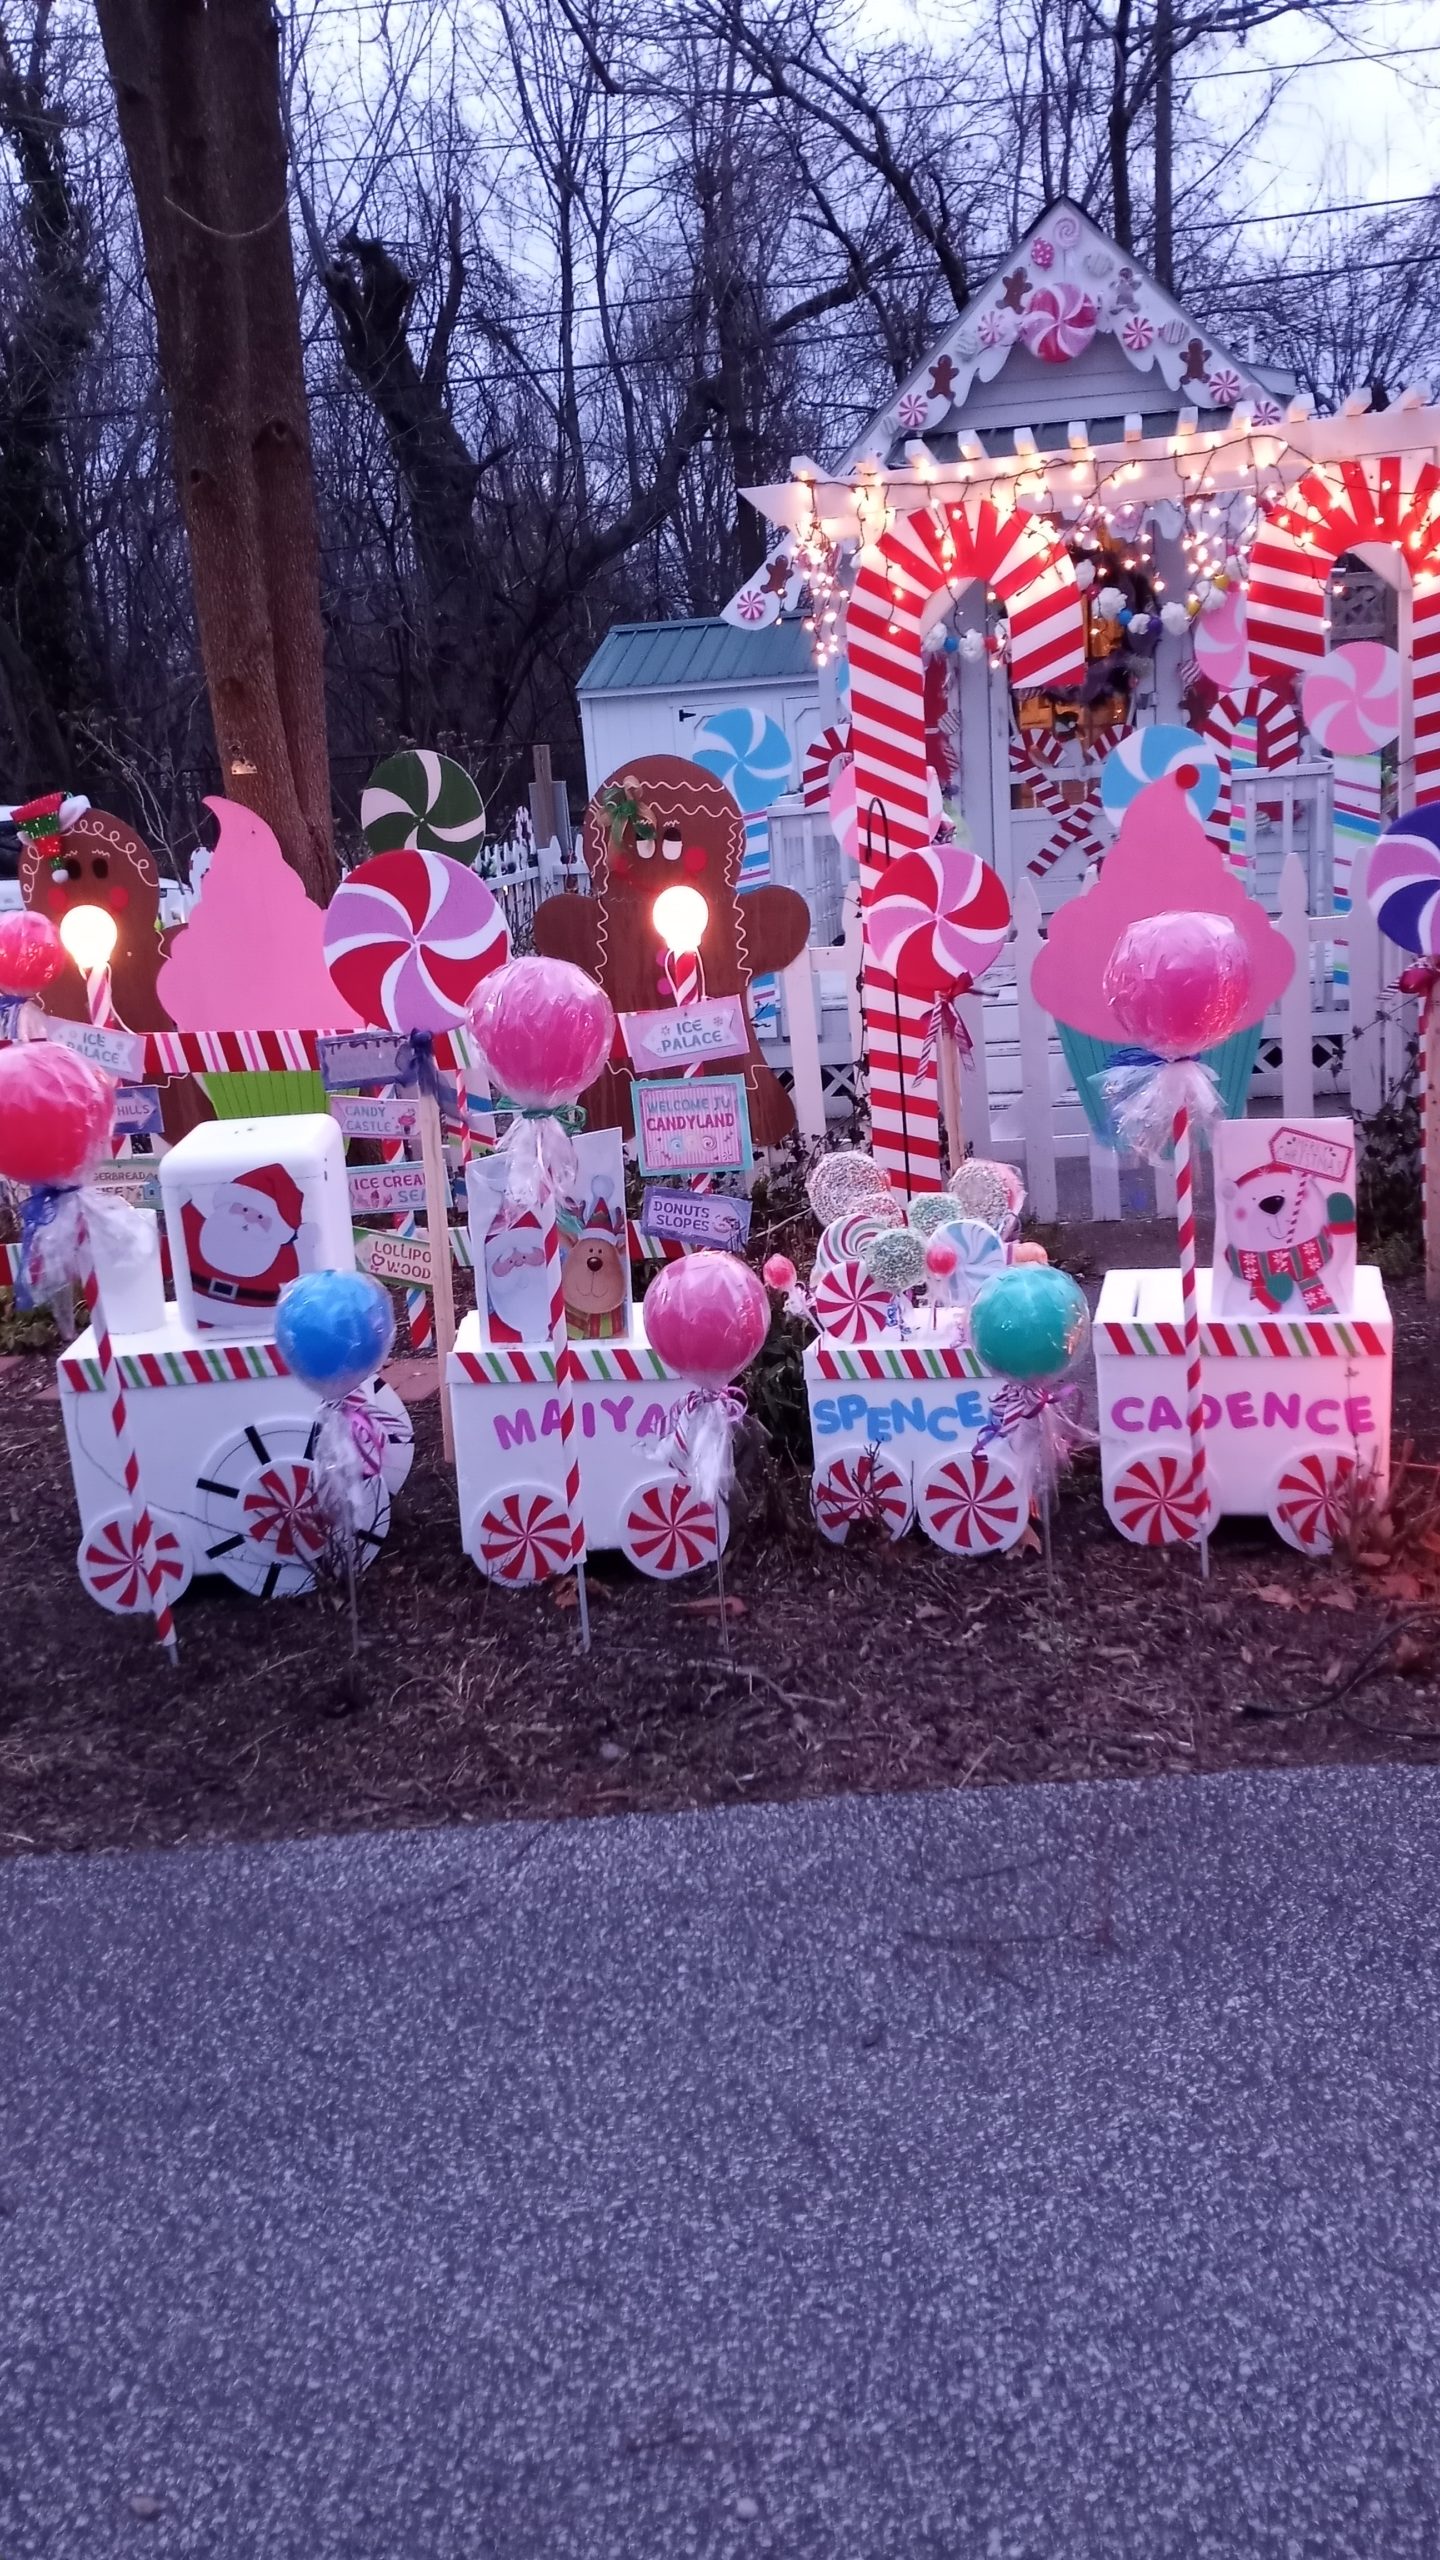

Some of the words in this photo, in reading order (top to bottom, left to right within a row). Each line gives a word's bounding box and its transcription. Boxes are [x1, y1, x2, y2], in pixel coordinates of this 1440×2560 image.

[676, 1019, 703, 1035] ICE
[83, 1032, 105, 1047] ICE
[661, 1030, 723, 1053] PALACE
[117, 1104, 150, 1116] HILLS
[345, 1105, 386, 1118] CANDY
[647, 1098, 709, 1113] WELCOME
[346, 1120, 392, 1132] CASTLE
[646, 1112, 735, 1132] CANDYLAND
[354, 1177, 380, 1190] ICE
[653, 1201, 710, 1219] DONUTS
[656, 1214, 710, 1232] SLOPES
[374, 1240, 432, 1263] LOLLIPO
[813, 1390, 994, 1442] SPENCE
[1111, 1391, 1376, 1435] CADENCE
[493, 1395, 666, 1450] MAIYA
